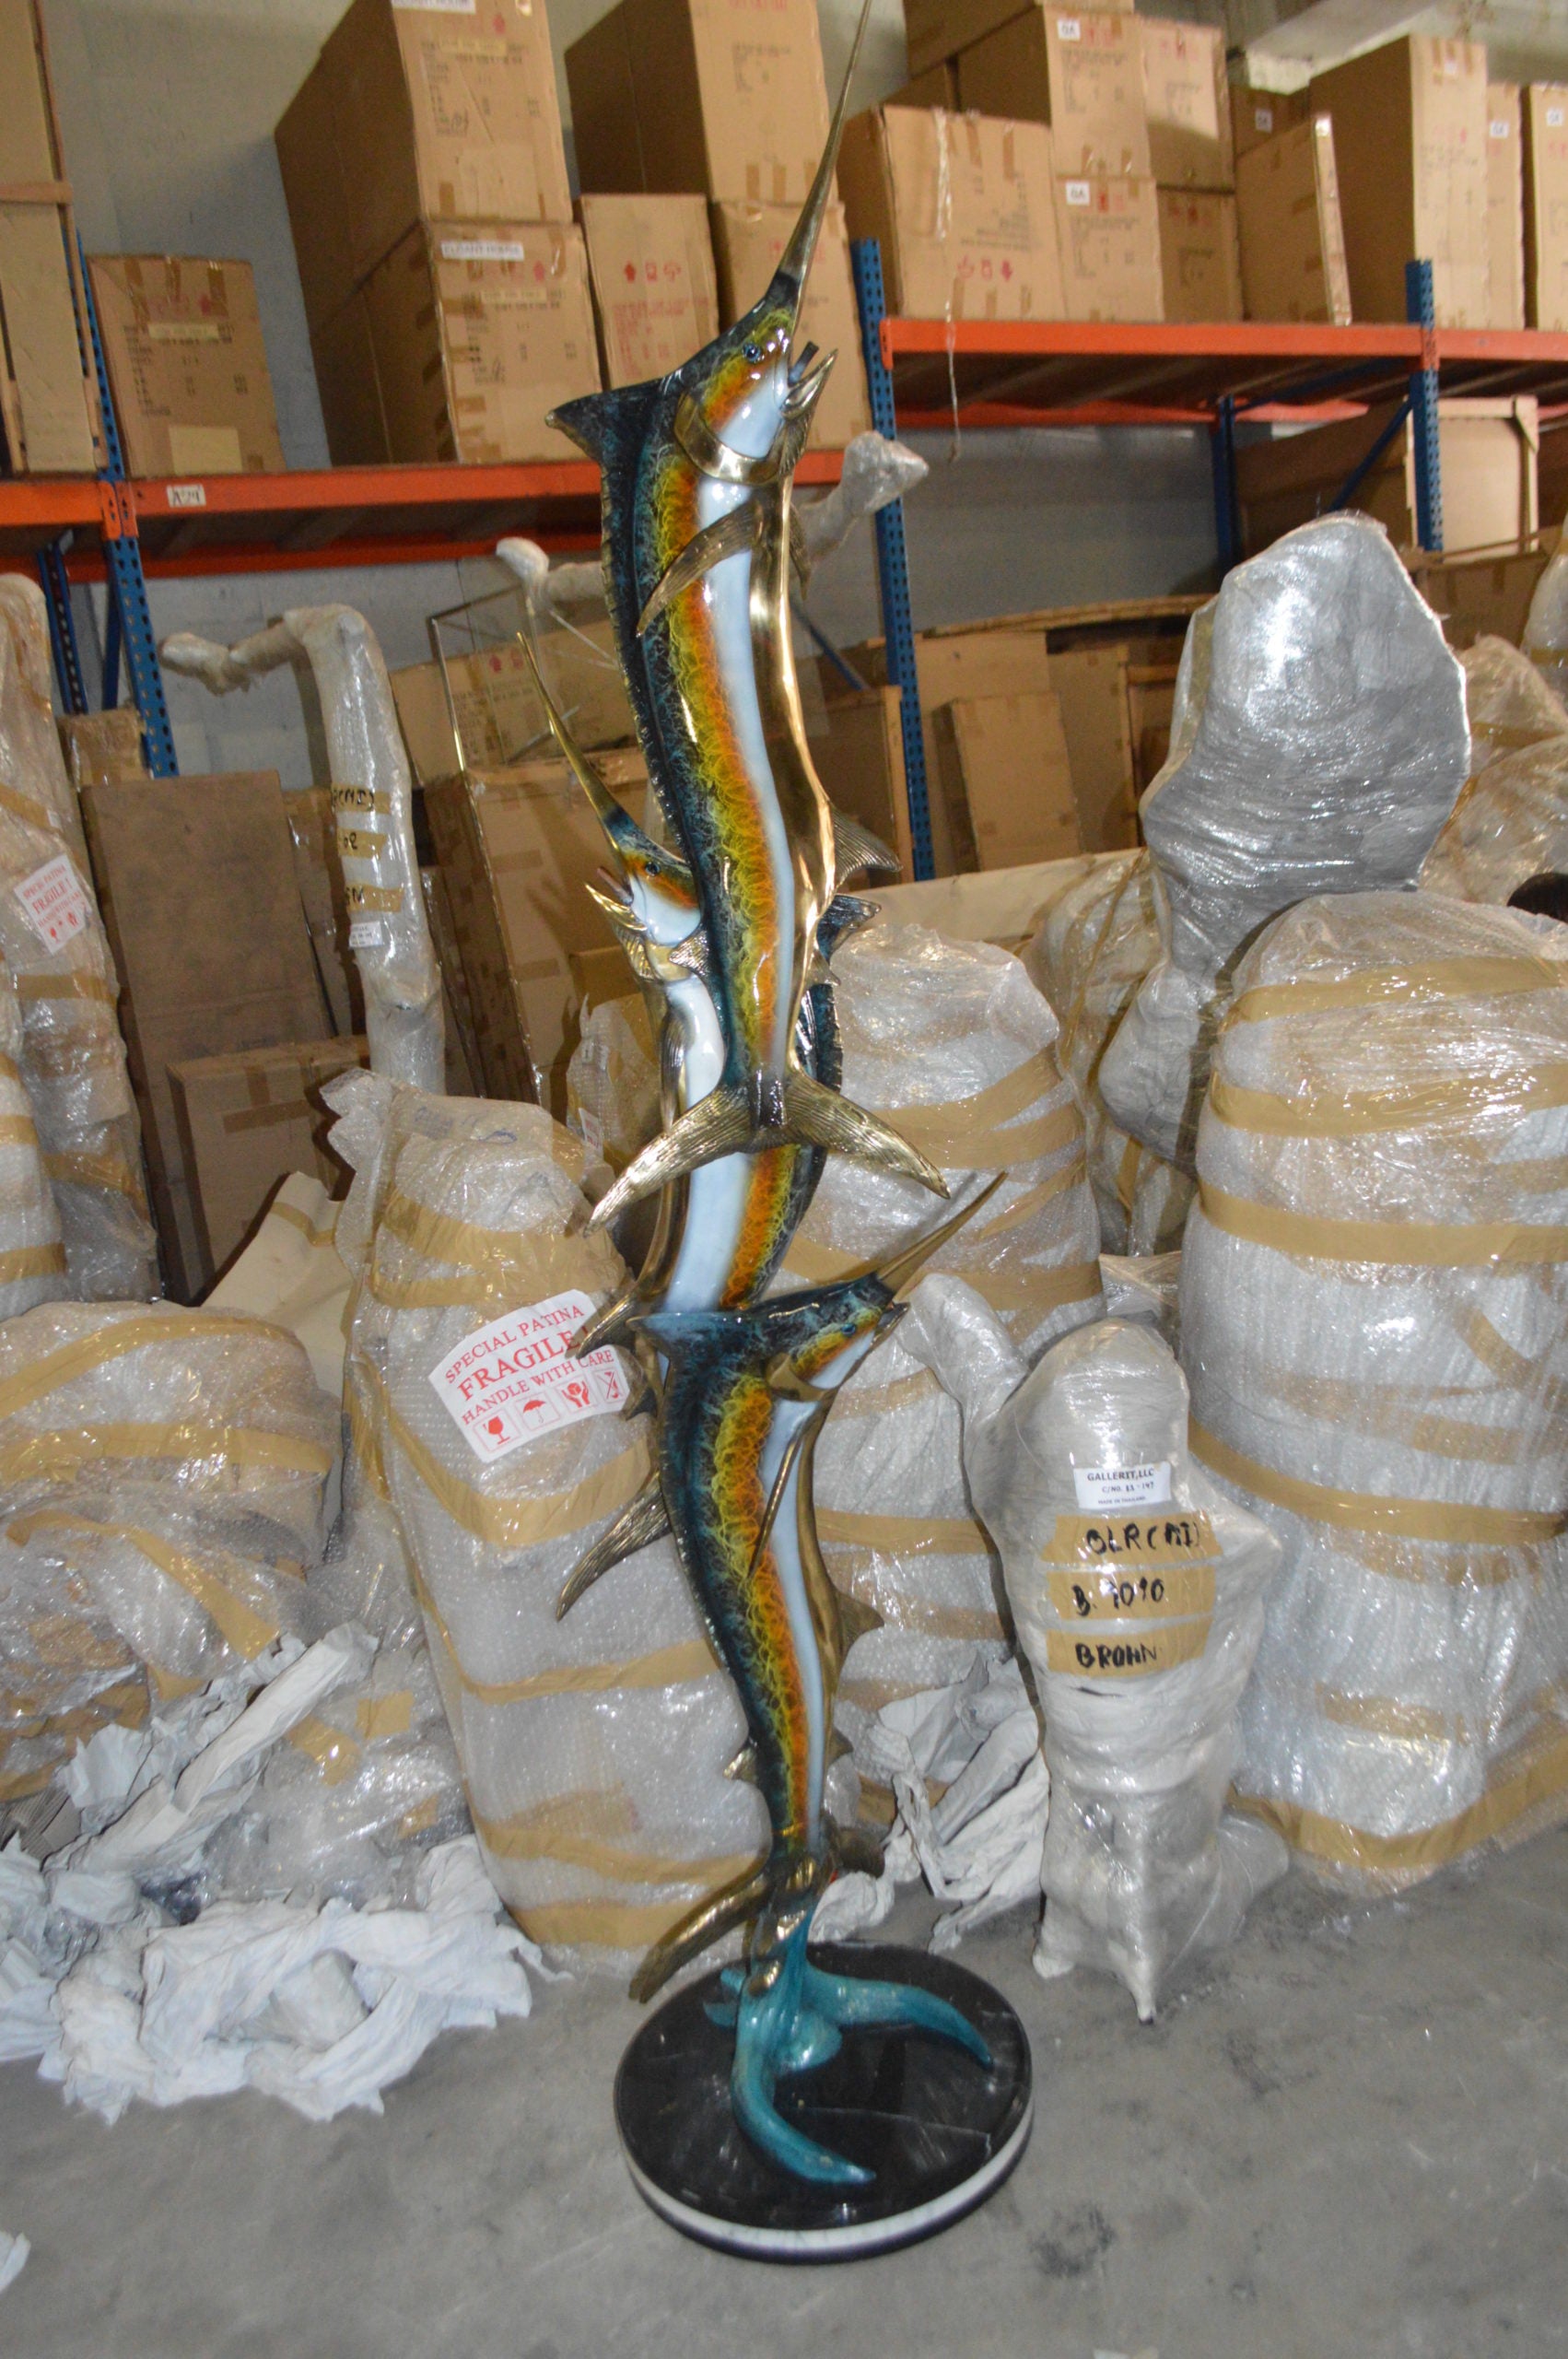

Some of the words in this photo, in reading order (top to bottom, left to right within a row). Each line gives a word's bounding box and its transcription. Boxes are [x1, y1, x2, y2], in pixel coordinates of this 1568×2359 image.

[32, 881, 66, 914] FRAGILE
[445, 1331, 517, 1383] SPECIAL
[519, 1305, 585, 1337] PATINA
[457, 1331, 580, 1402] FRAGILE
[462, 1380, 530, 1425] HANDLE
[531, 1360, 575, 1389] WITH
[578, 1349, 614, 1369] CARE
